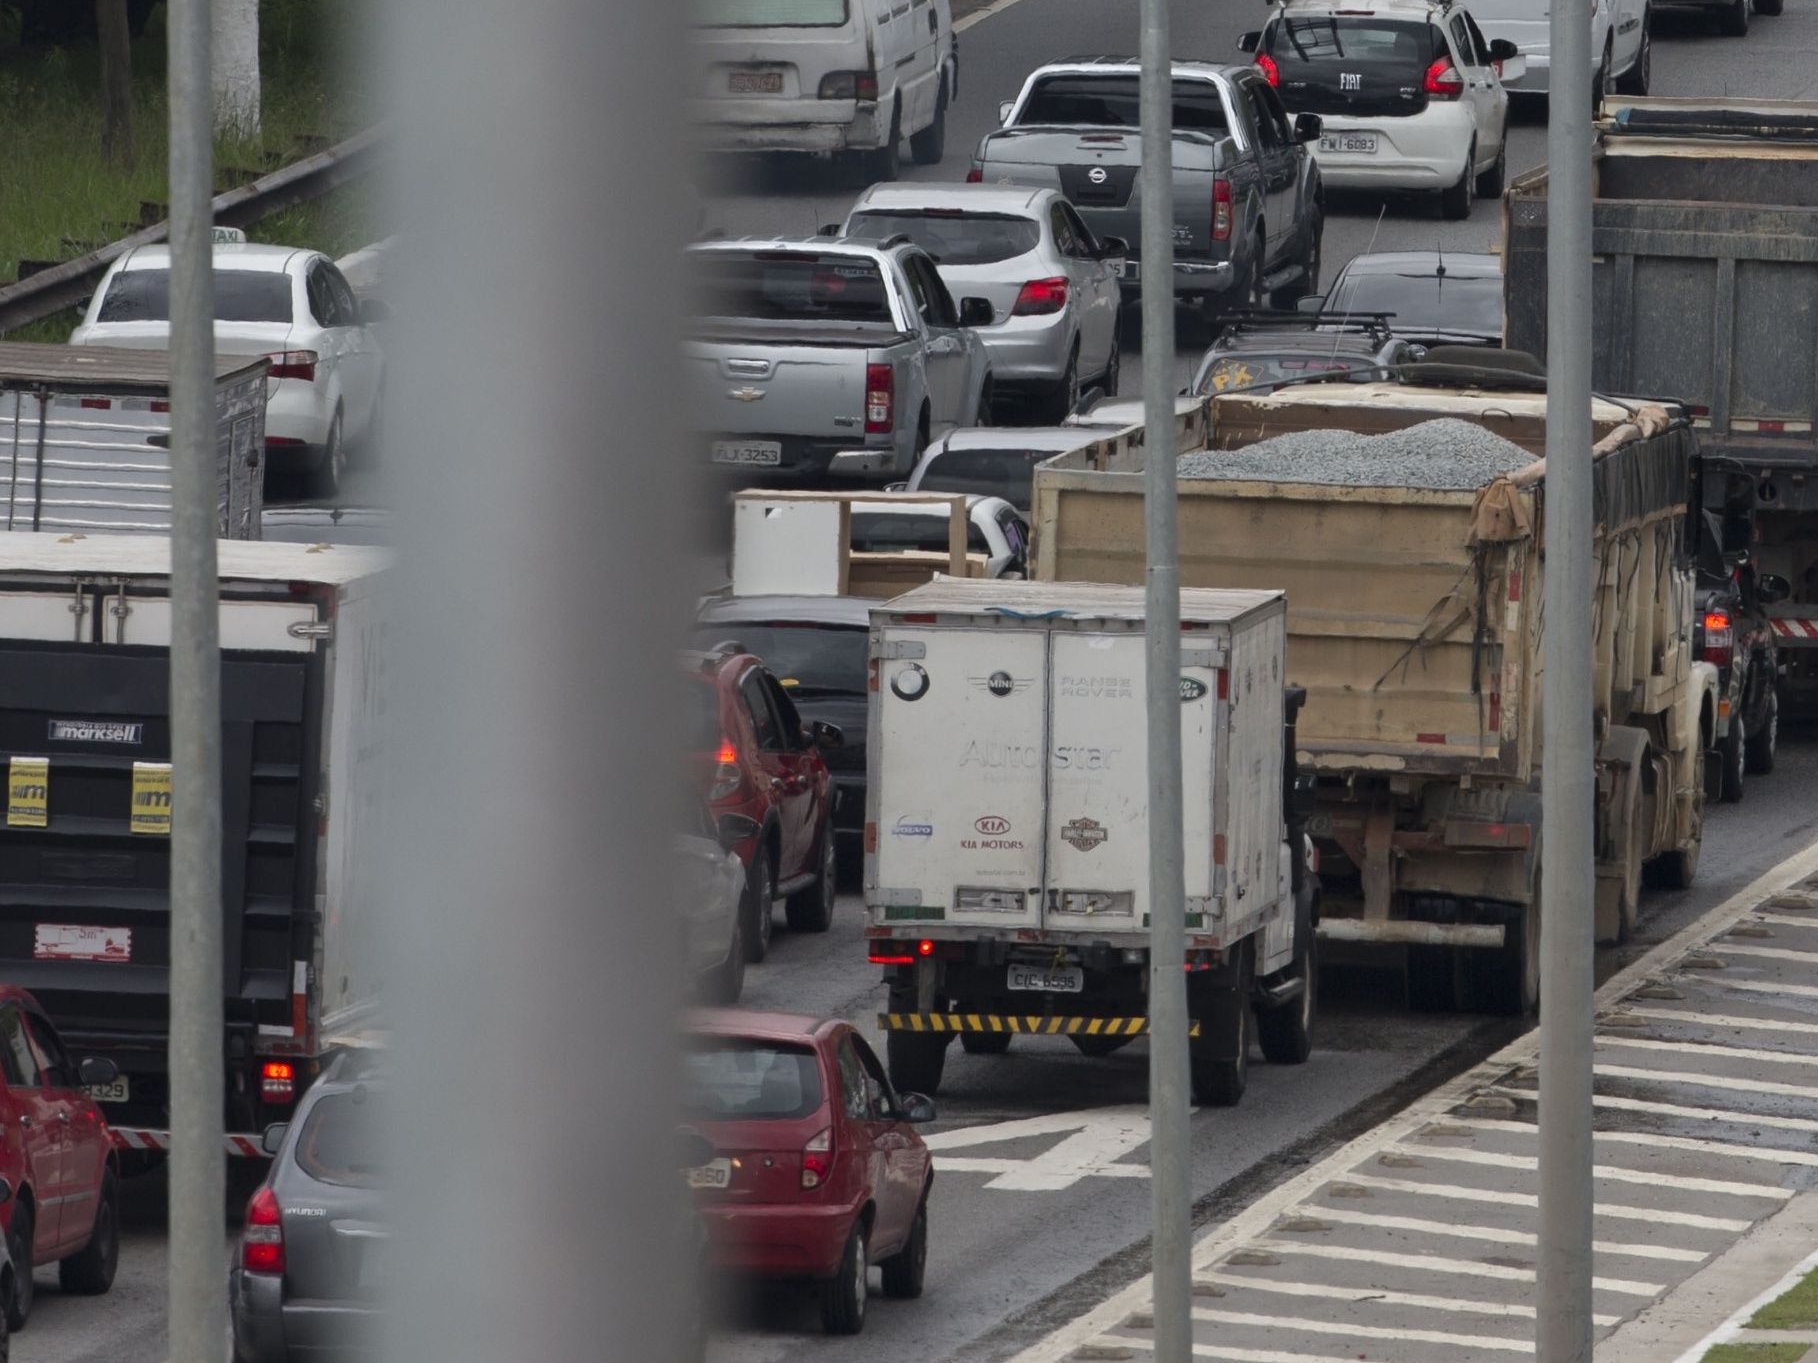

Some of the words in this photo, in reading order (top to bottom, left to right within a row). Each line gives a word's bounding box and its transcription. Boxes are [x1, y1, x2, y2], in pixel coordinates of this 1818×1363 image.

[1340, 73, 1363, 91] FIAT
[211, 228, 239, 242] TAXI
[989, 678, 1013, 688] MINI
[1061, 675, 1131, 688] RANGE
[1061, 687, 1132, 698] ROVER
[60, 725, 136, 742] marksell
[894, 825, 931, 834] VOLVO
[981, 820, 1006, 832] KIA
[960, 839, 978, 849] KIA
[981, 839, 1024, 850] MOTORS
